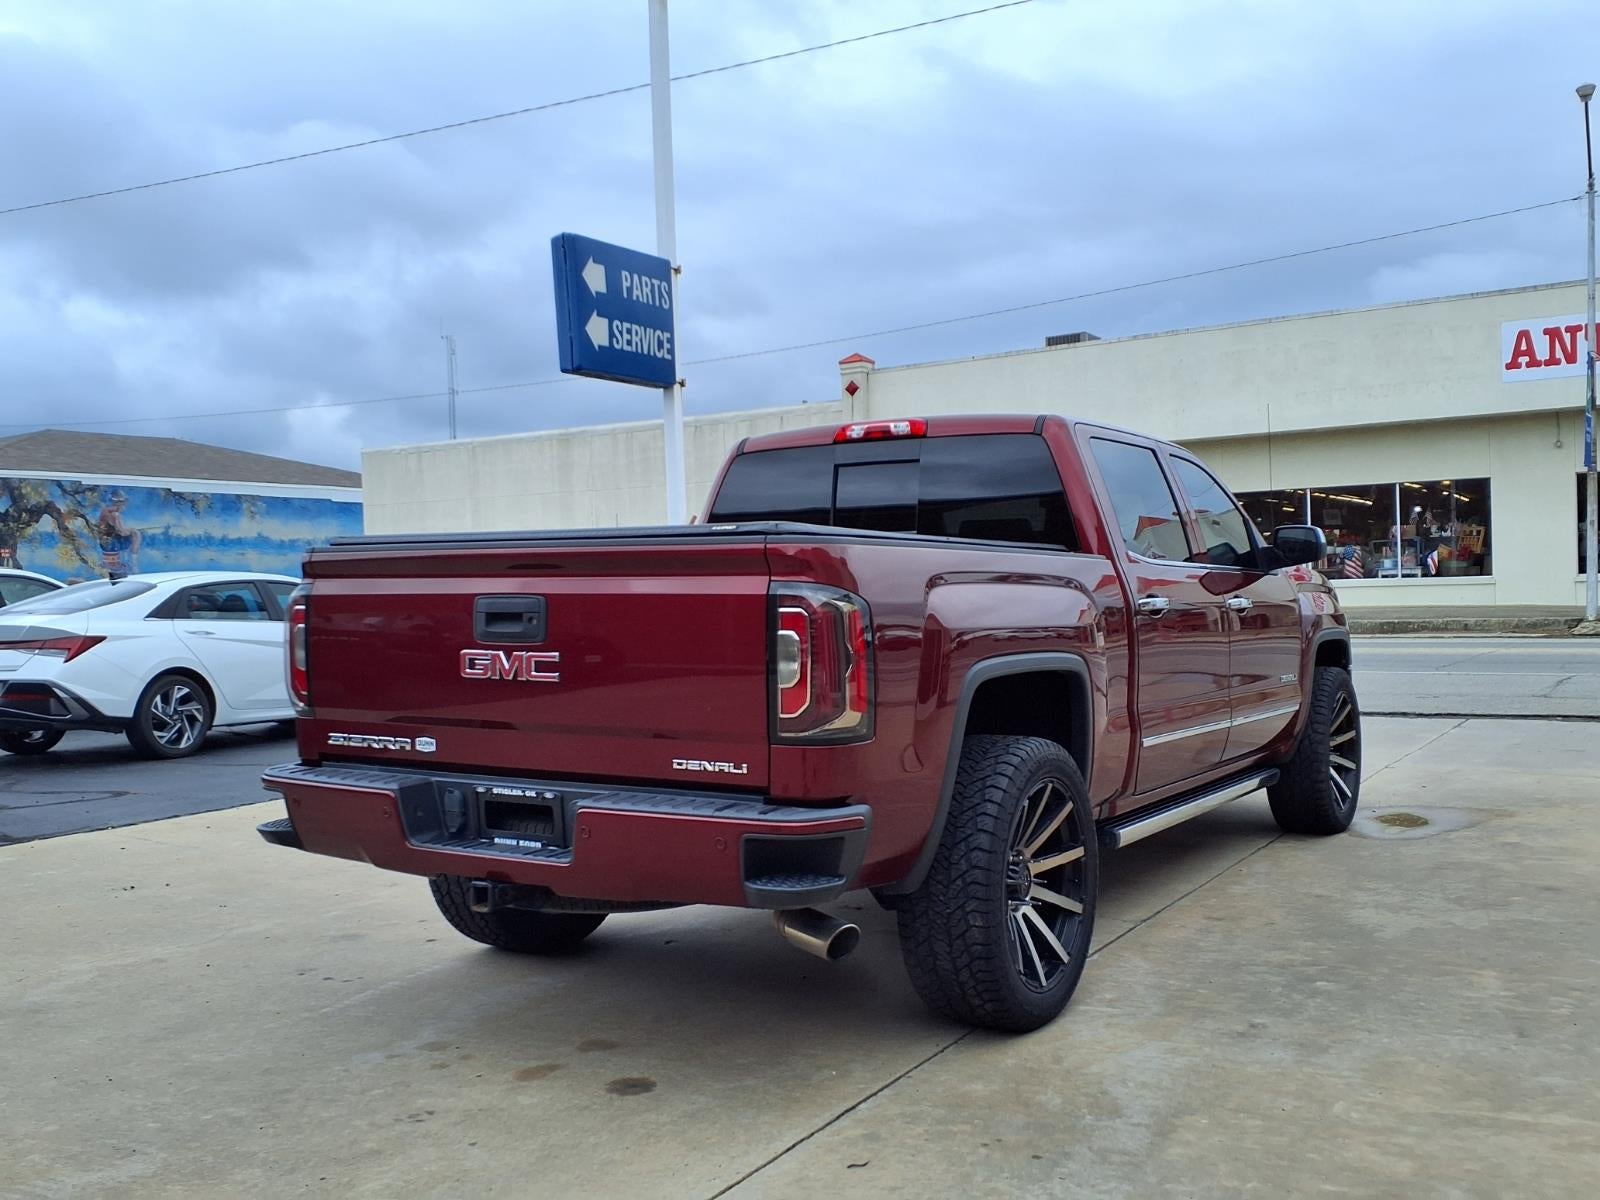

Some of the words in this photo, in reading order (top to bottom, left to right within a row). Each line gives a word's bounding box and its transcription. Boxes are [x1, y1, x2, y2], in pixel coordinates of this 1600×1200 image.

[621, 270, 670, 310] PARTS
[612, 319, 673, 361] SERVICE
[460, 649, 560, 682] GMC
[327, 732, 412, 751] SIERRA
[672, 759, 748, 774] DENALI
